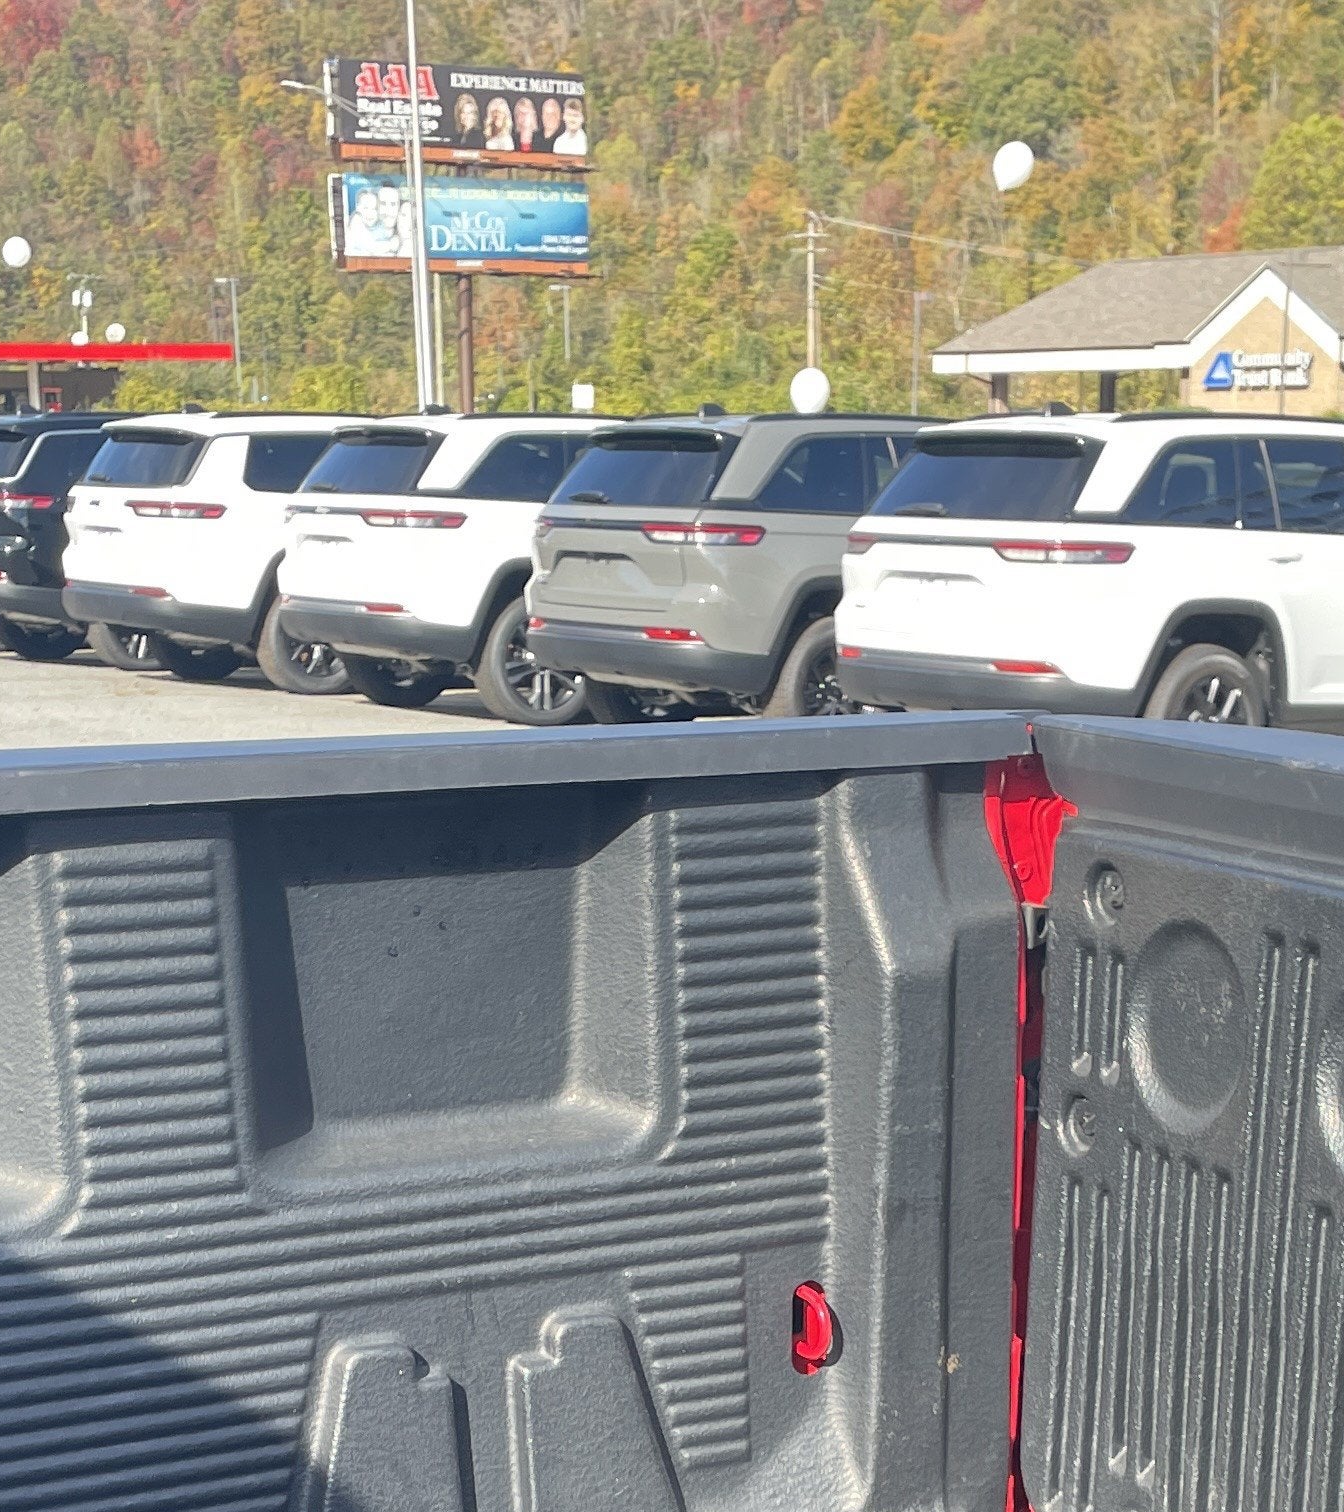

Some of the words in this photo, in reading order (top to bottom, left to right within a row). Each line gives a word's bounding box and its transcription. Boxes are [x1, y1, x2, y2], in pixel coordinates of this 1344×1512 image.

[450, 72, 527, 92] EXPERIENCE
[529, 79, 586, 96] MATTERS
[392, 100, 443, 117] Esate
[1232, 348, 1312, 370] Community
[1231, 368, 1269, 386] Trust
[1269, 367, 1309, 386] Bank
